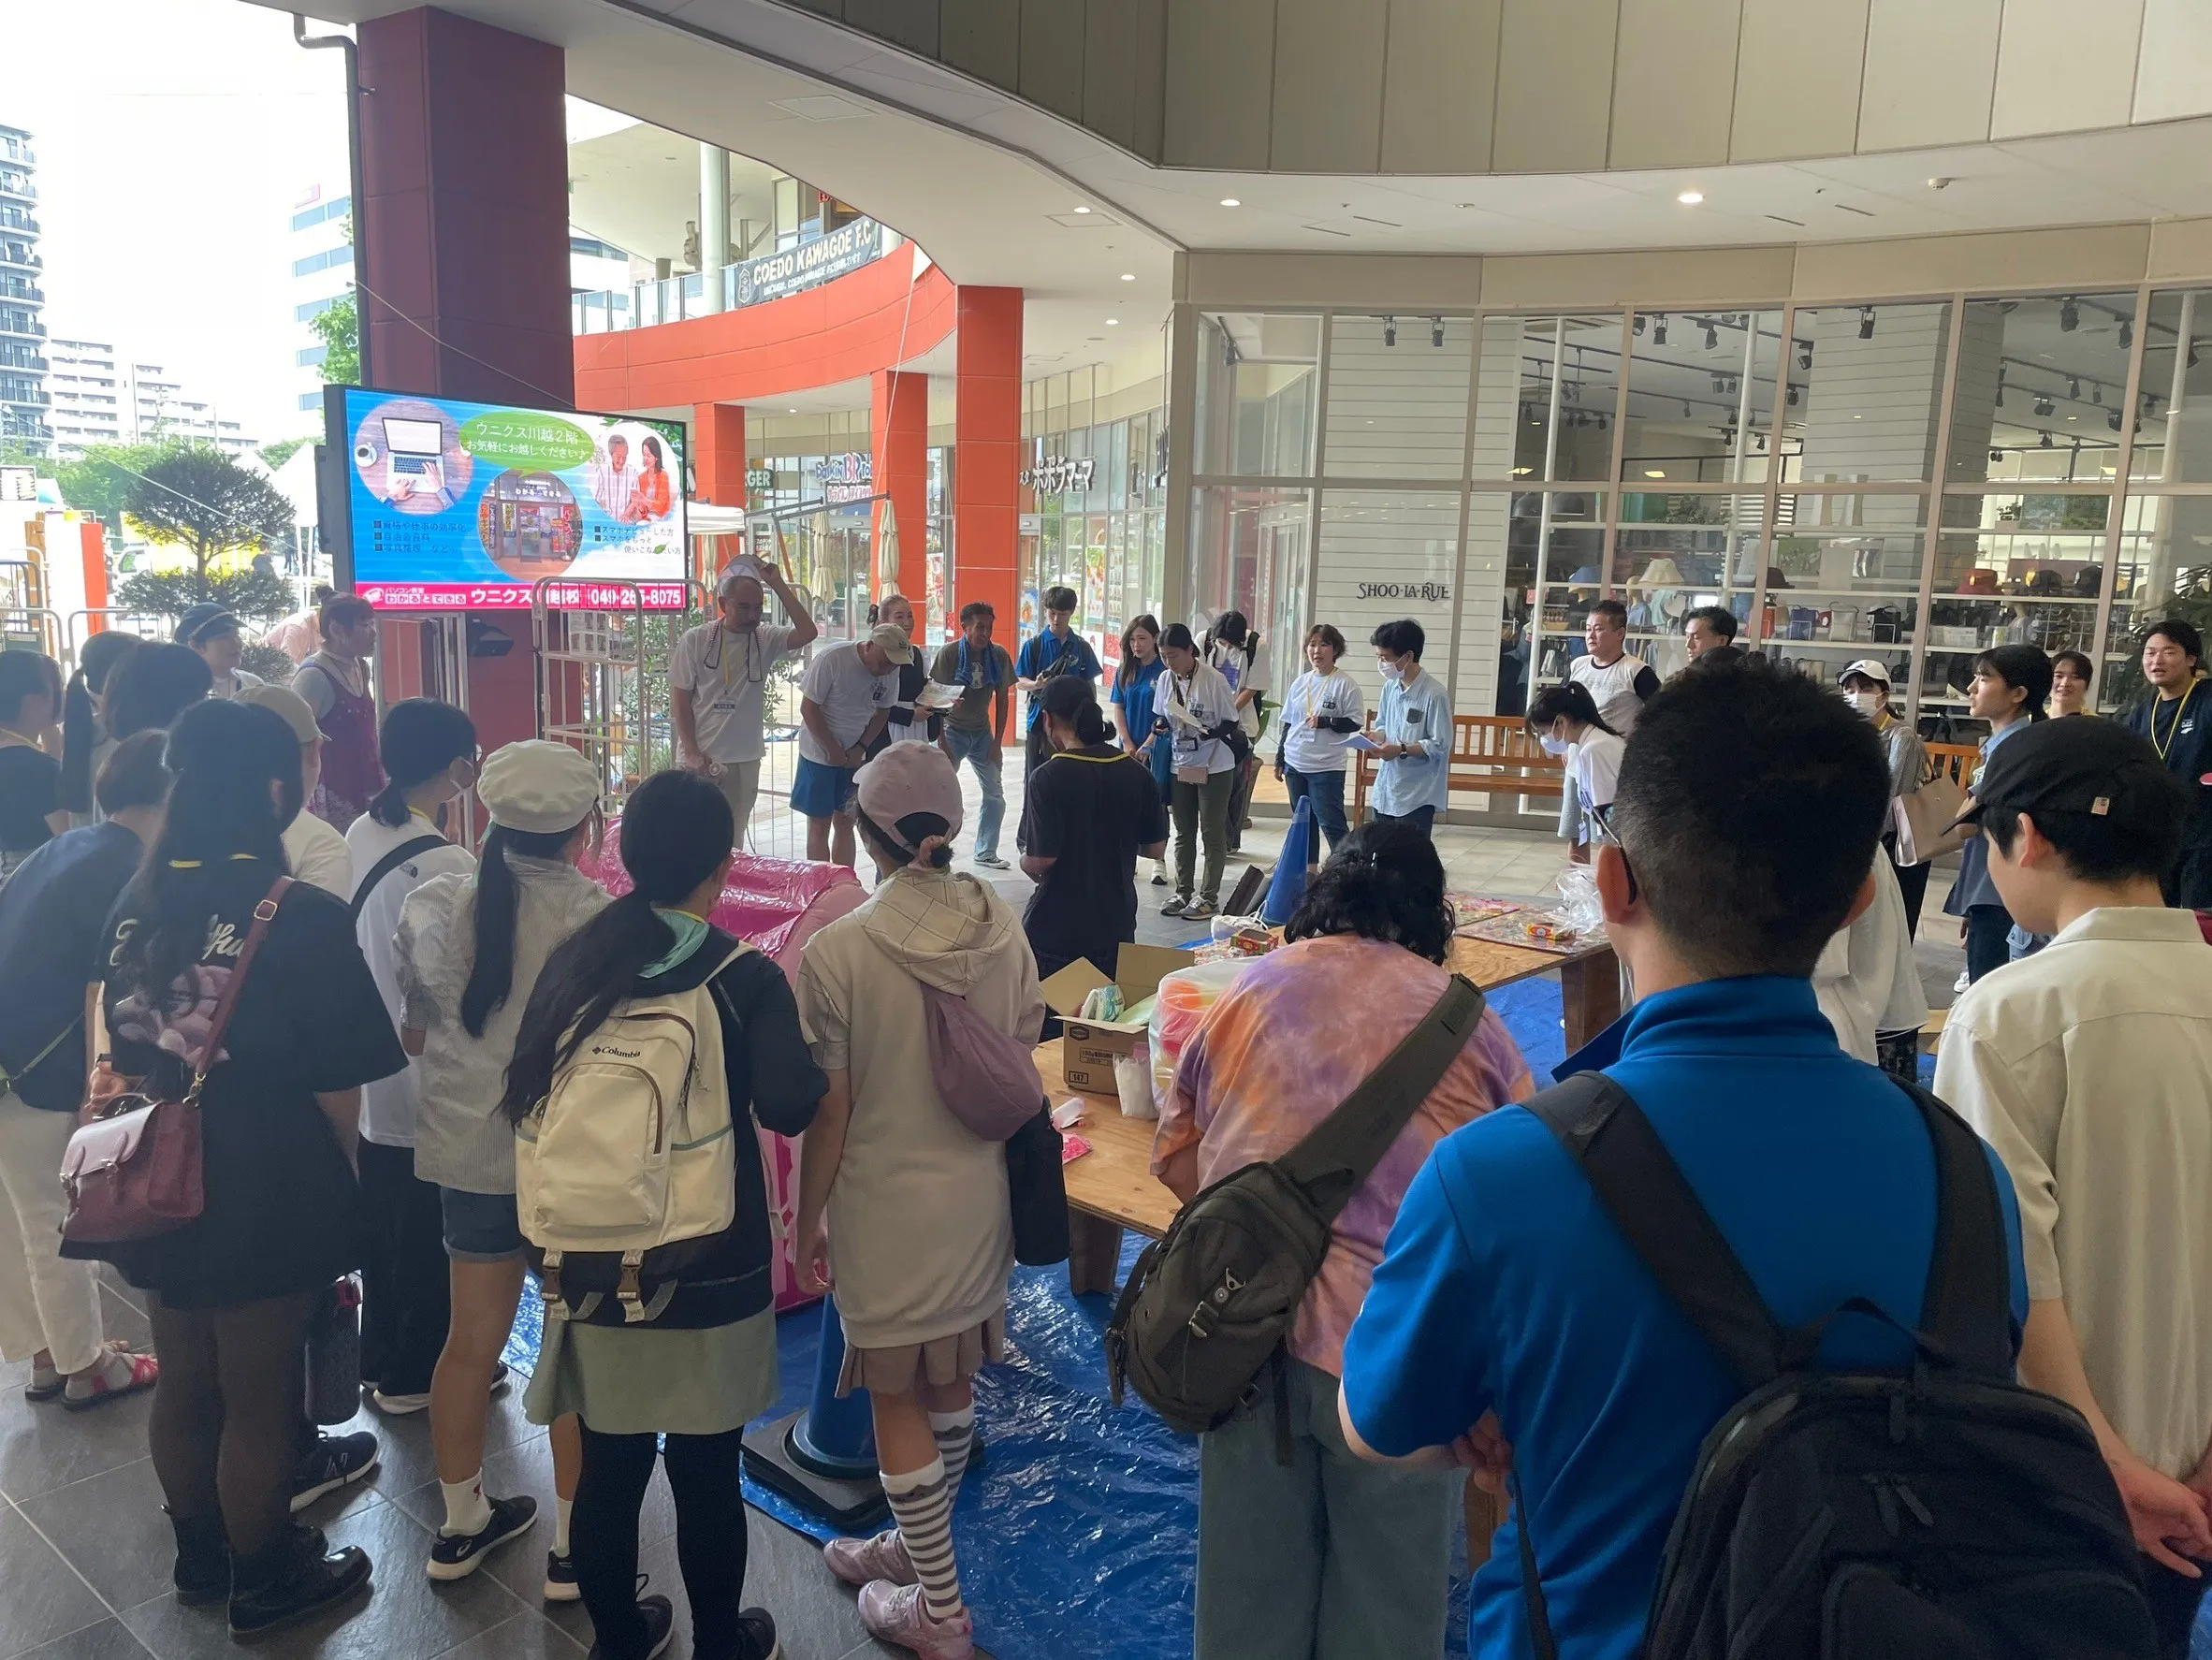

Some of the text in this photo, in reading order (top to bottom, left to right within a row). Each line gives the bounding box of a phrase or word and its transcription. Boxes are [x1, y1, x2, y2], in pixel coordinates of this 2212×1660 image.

[753, 254, 793, 285] COEDO
[796, 229, 852, 272] KAWAGOE
[745, 470, 771, 487] GER
[602, 534, 652, 544] スマホをもっと
[624, 545, 681, 555] 使いこない方
[385, 593, 467, 605] わかるとできる
[602, 1046, 641, 1058] Columbia
[1072, 1072, 1084, 1082] 147
